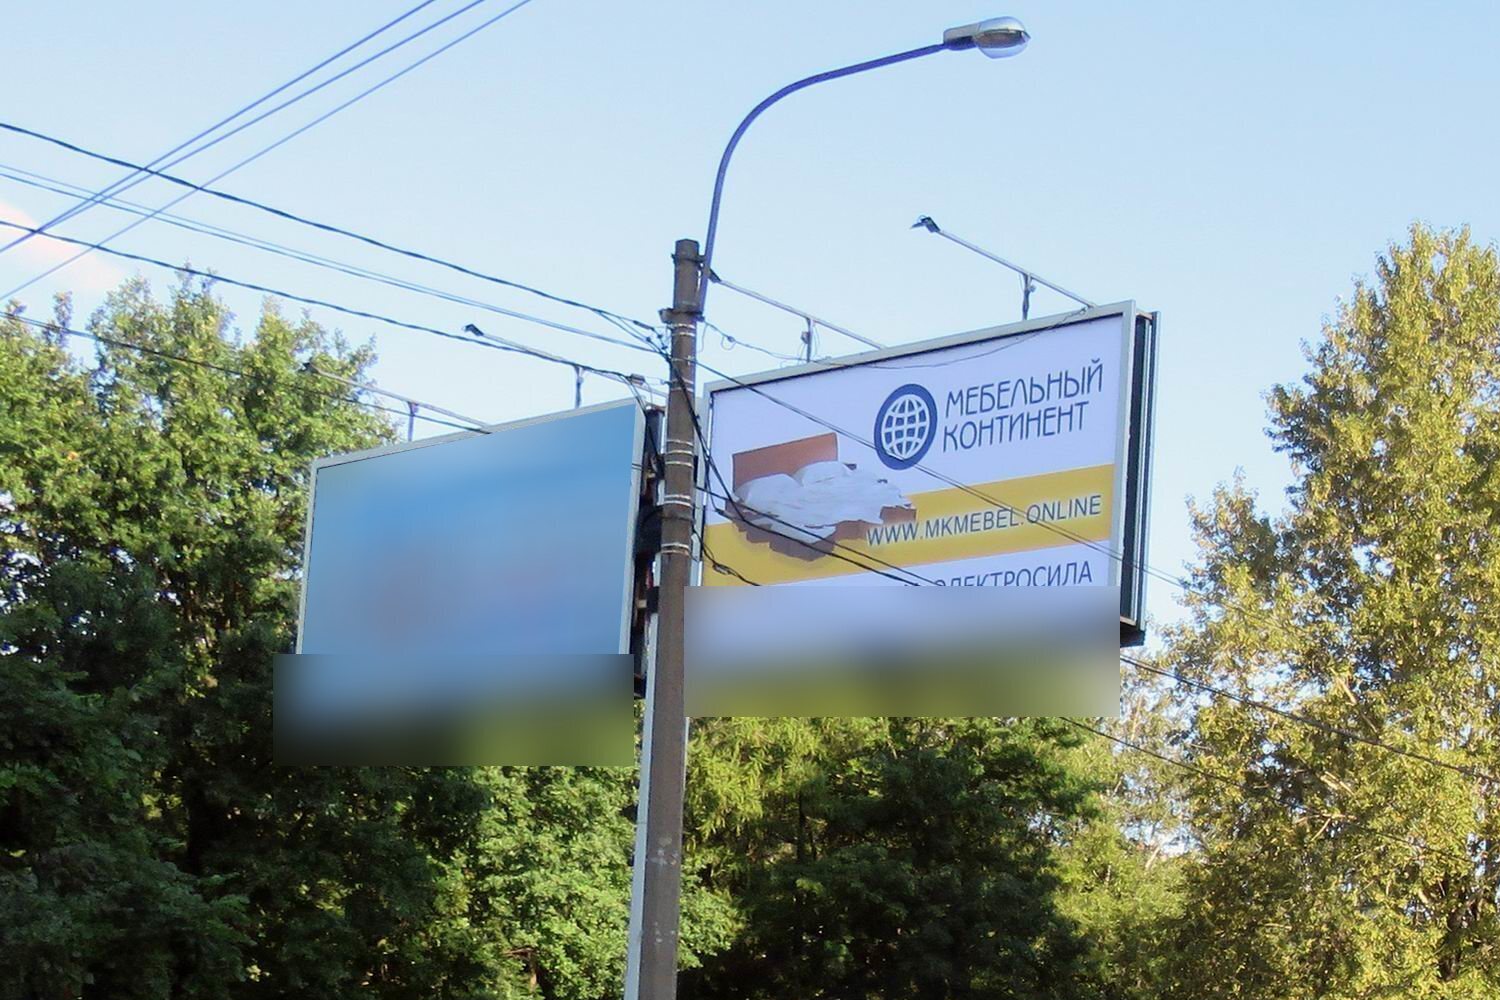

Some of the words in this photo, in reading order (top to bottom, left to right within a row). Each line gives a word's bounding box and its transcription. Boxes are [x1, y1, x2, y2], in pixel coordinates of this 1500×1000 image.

[945, 358, 1103, 418] МЕБЕЛЬНЫЙ
[943, 401, 1089, 453] КОНТИНЕНТ
[867, 495, 1101, 546] WWW.MKMEBEL.ONLINE
